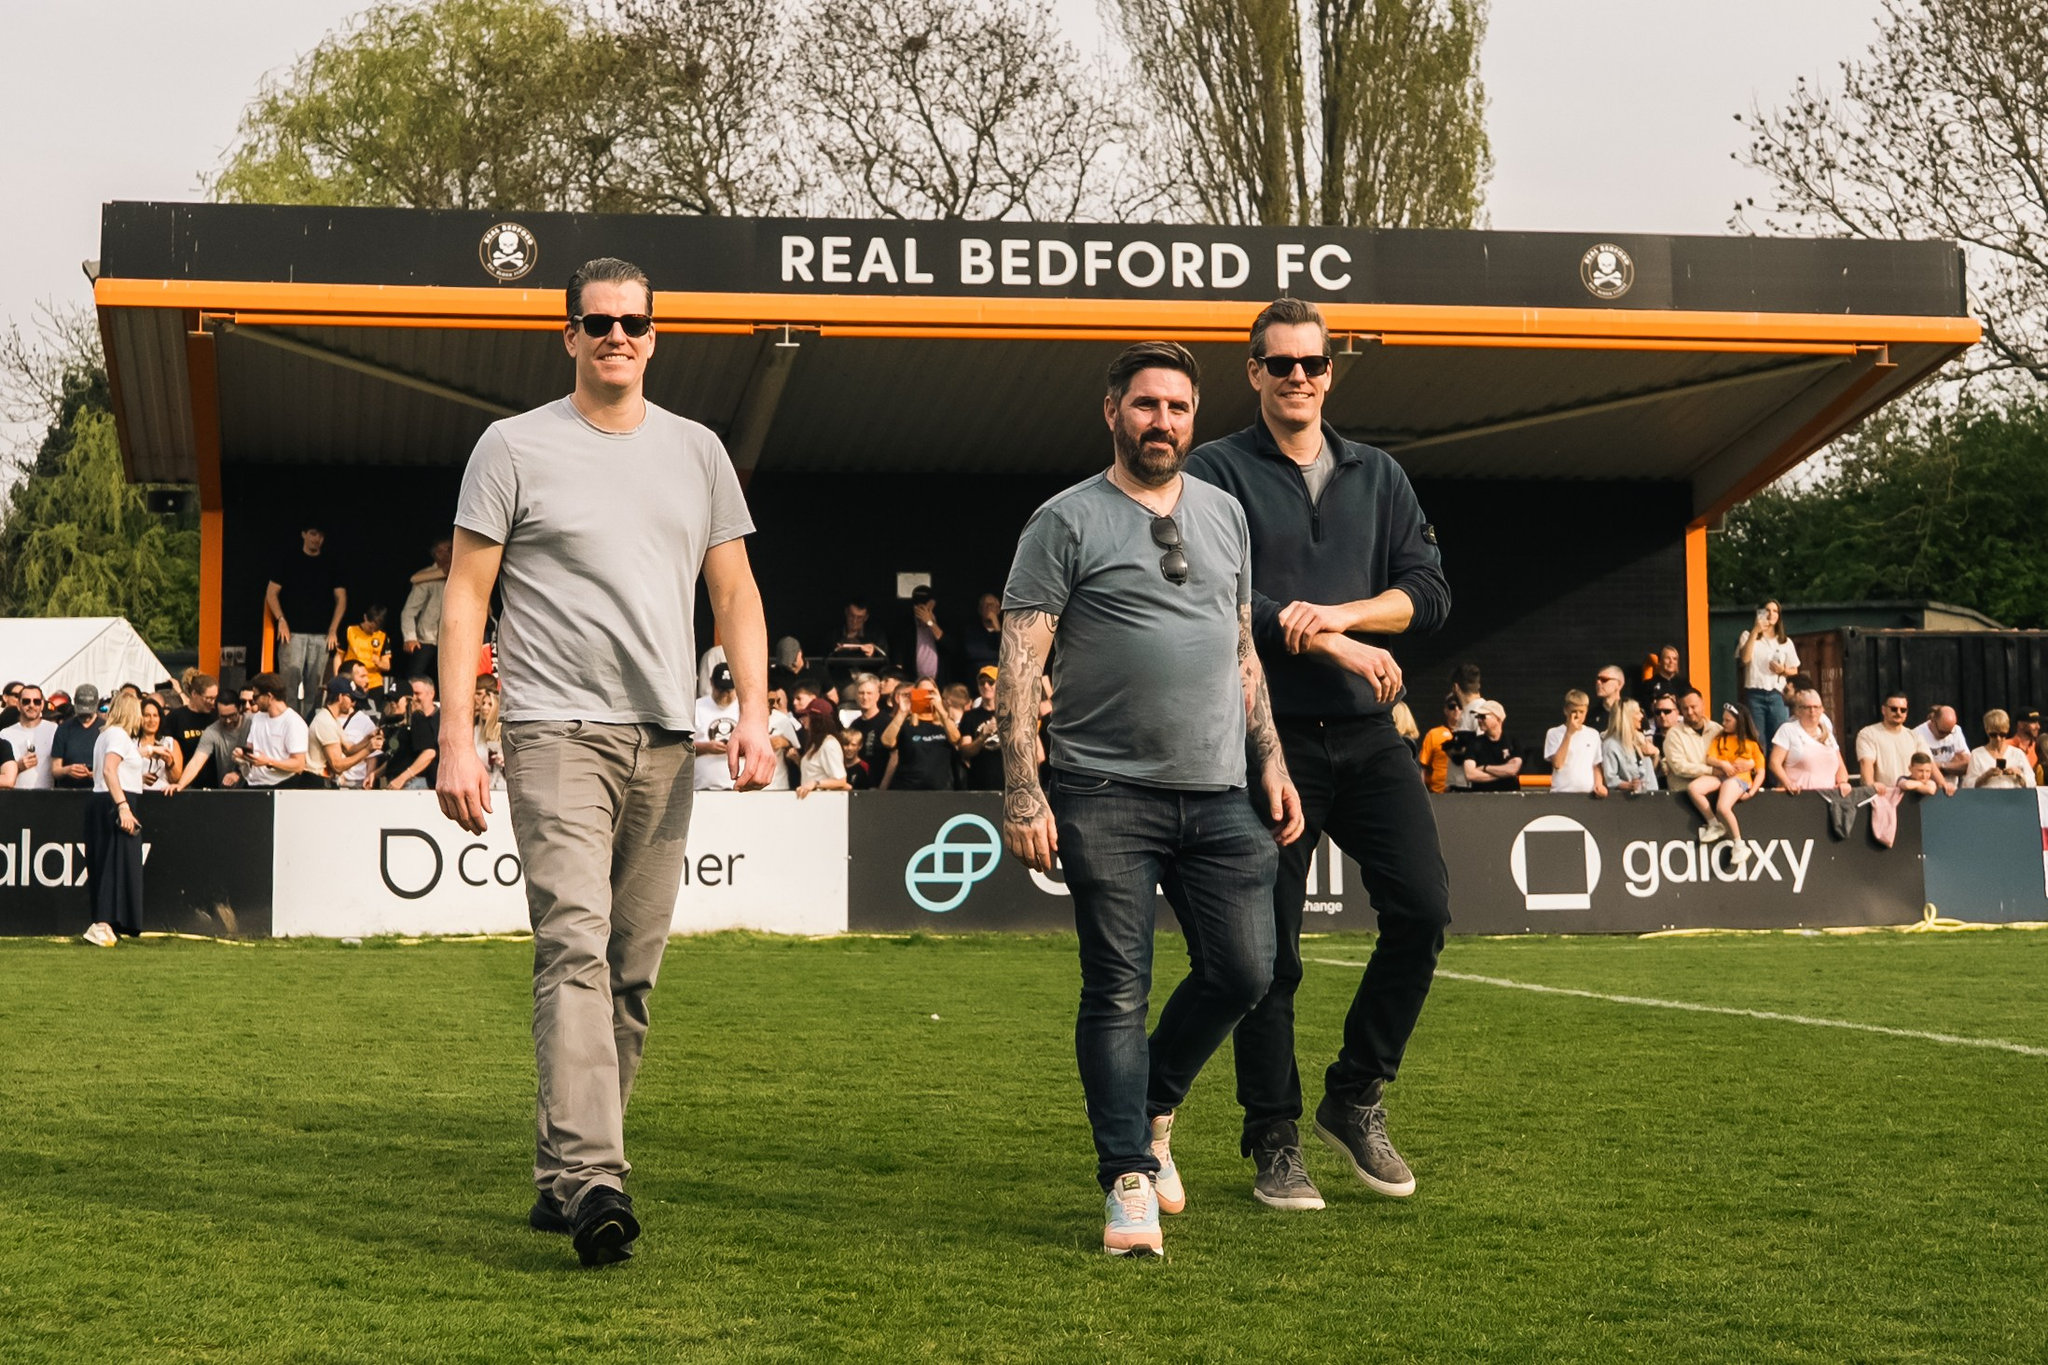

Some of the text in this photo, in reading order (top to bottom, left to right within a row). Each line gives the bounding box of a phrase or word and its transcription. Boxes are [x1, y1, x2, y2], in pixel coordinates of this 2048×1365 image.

[781, 236, 1352, 291] REAL BEDFORD FC
[1303, 900, 1343, 914] hange
